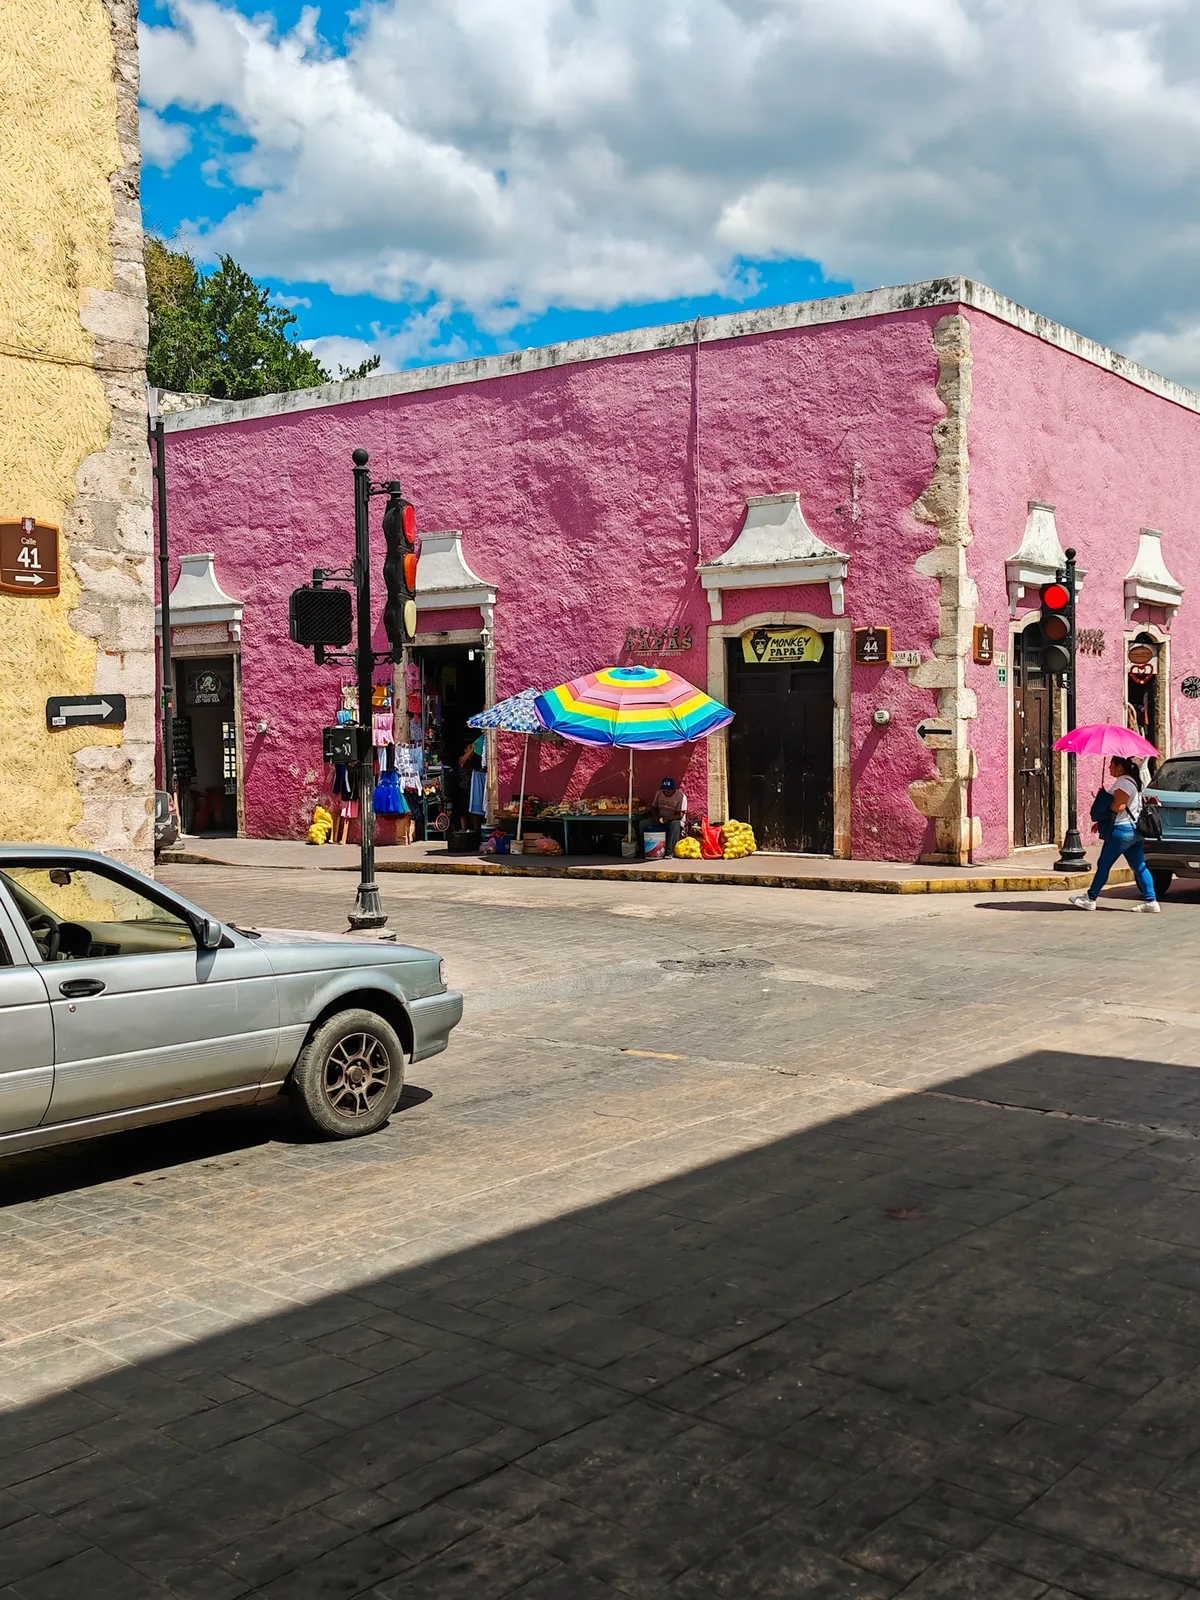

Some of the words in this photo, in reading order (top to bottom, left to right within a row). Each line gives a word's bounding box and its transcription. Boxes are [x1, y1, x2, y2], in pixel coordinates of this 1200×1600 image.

[21, 537, 37, 546] Calle
[17, 547, 42, 569] 41
[627, 625, 692, 637] MONKEY
[625, 637, 692, 650] PAPAS
[771, 637, 811, 648] MONKEY
[863, 641, 878, 652] 44
[982, 638, 990, 650] 41
[770, 647, 805, 656] PAPAS
